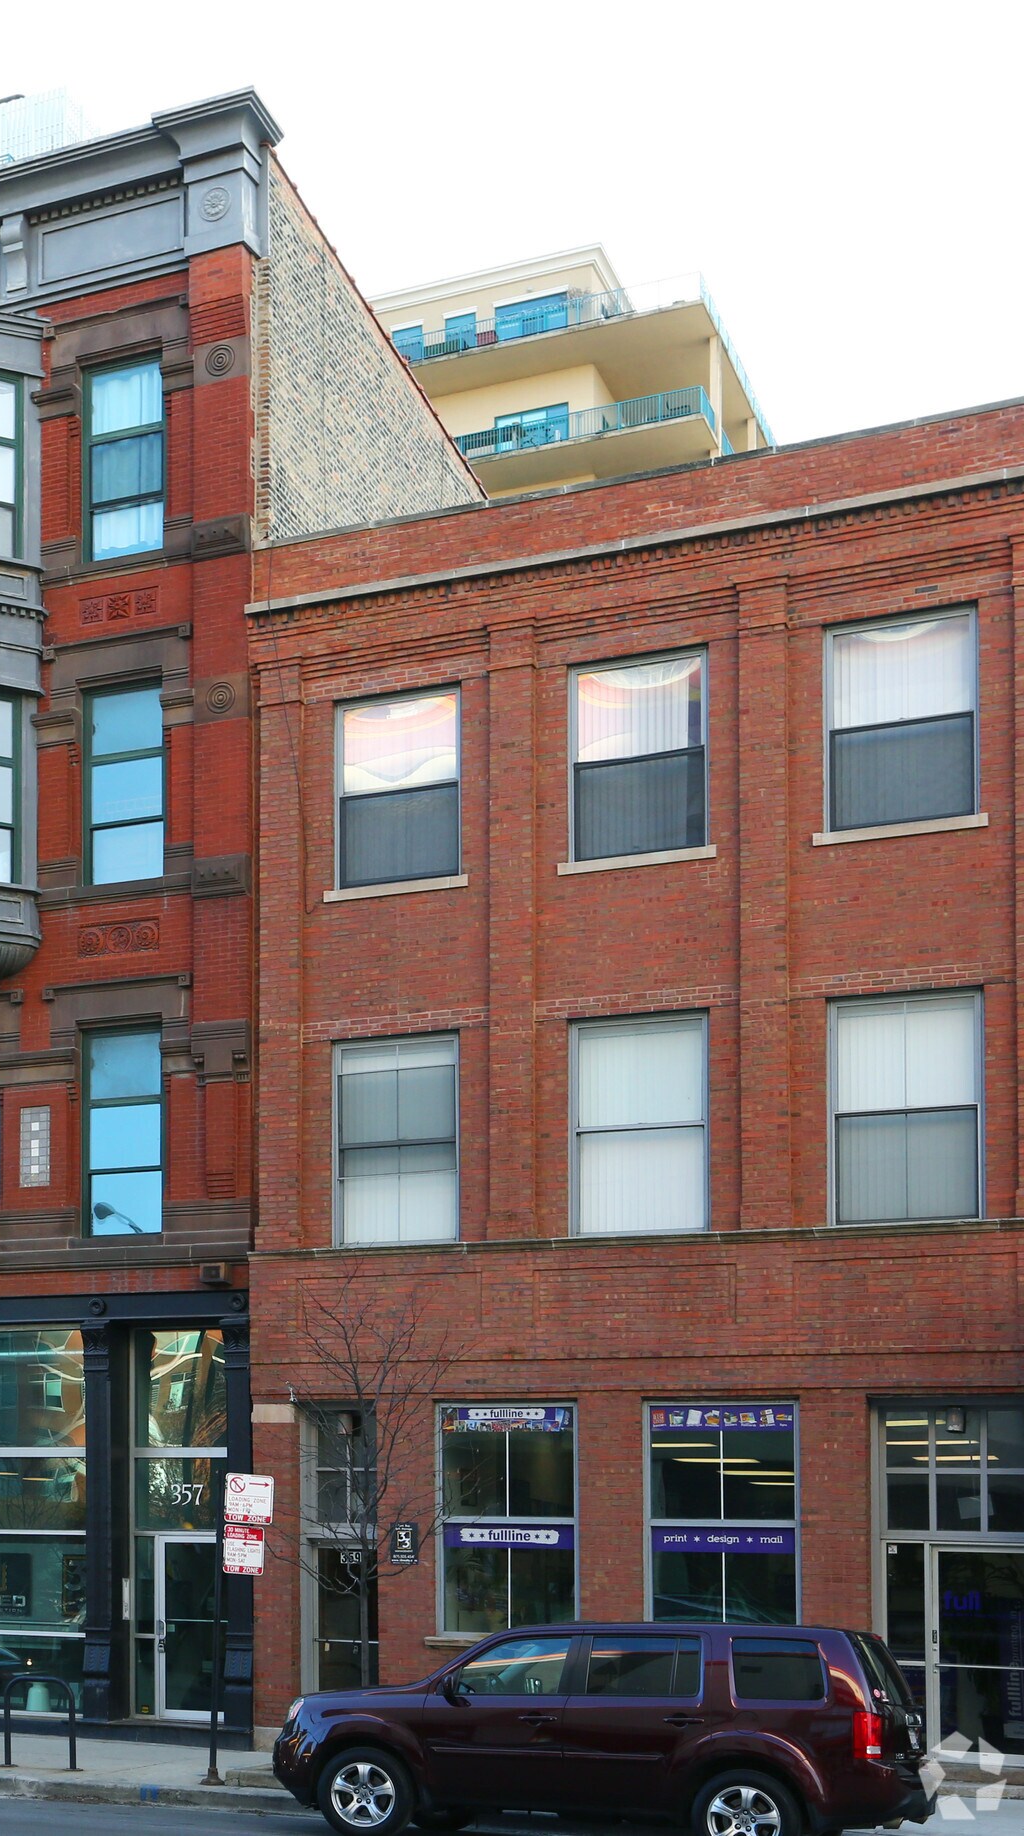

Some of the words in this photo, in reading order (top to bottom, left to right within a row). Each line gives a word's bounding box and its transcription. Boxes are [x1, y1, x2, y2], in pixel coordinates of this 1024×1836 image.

[489, 1409, 524, 1418] fullline
[170, 1483, 204, 1506] 357
[488, 1529, 531, 1541] fullline
[663, 1534, 688, 1544] print
[706, 1534, 740, 1545] design
[759, 1535, 784, 1544] mail
[226, 1565, 240, 1573] TOW
[242, 1566, 259, 1574] ZONE
[943, 1589, 982, 1611] full
